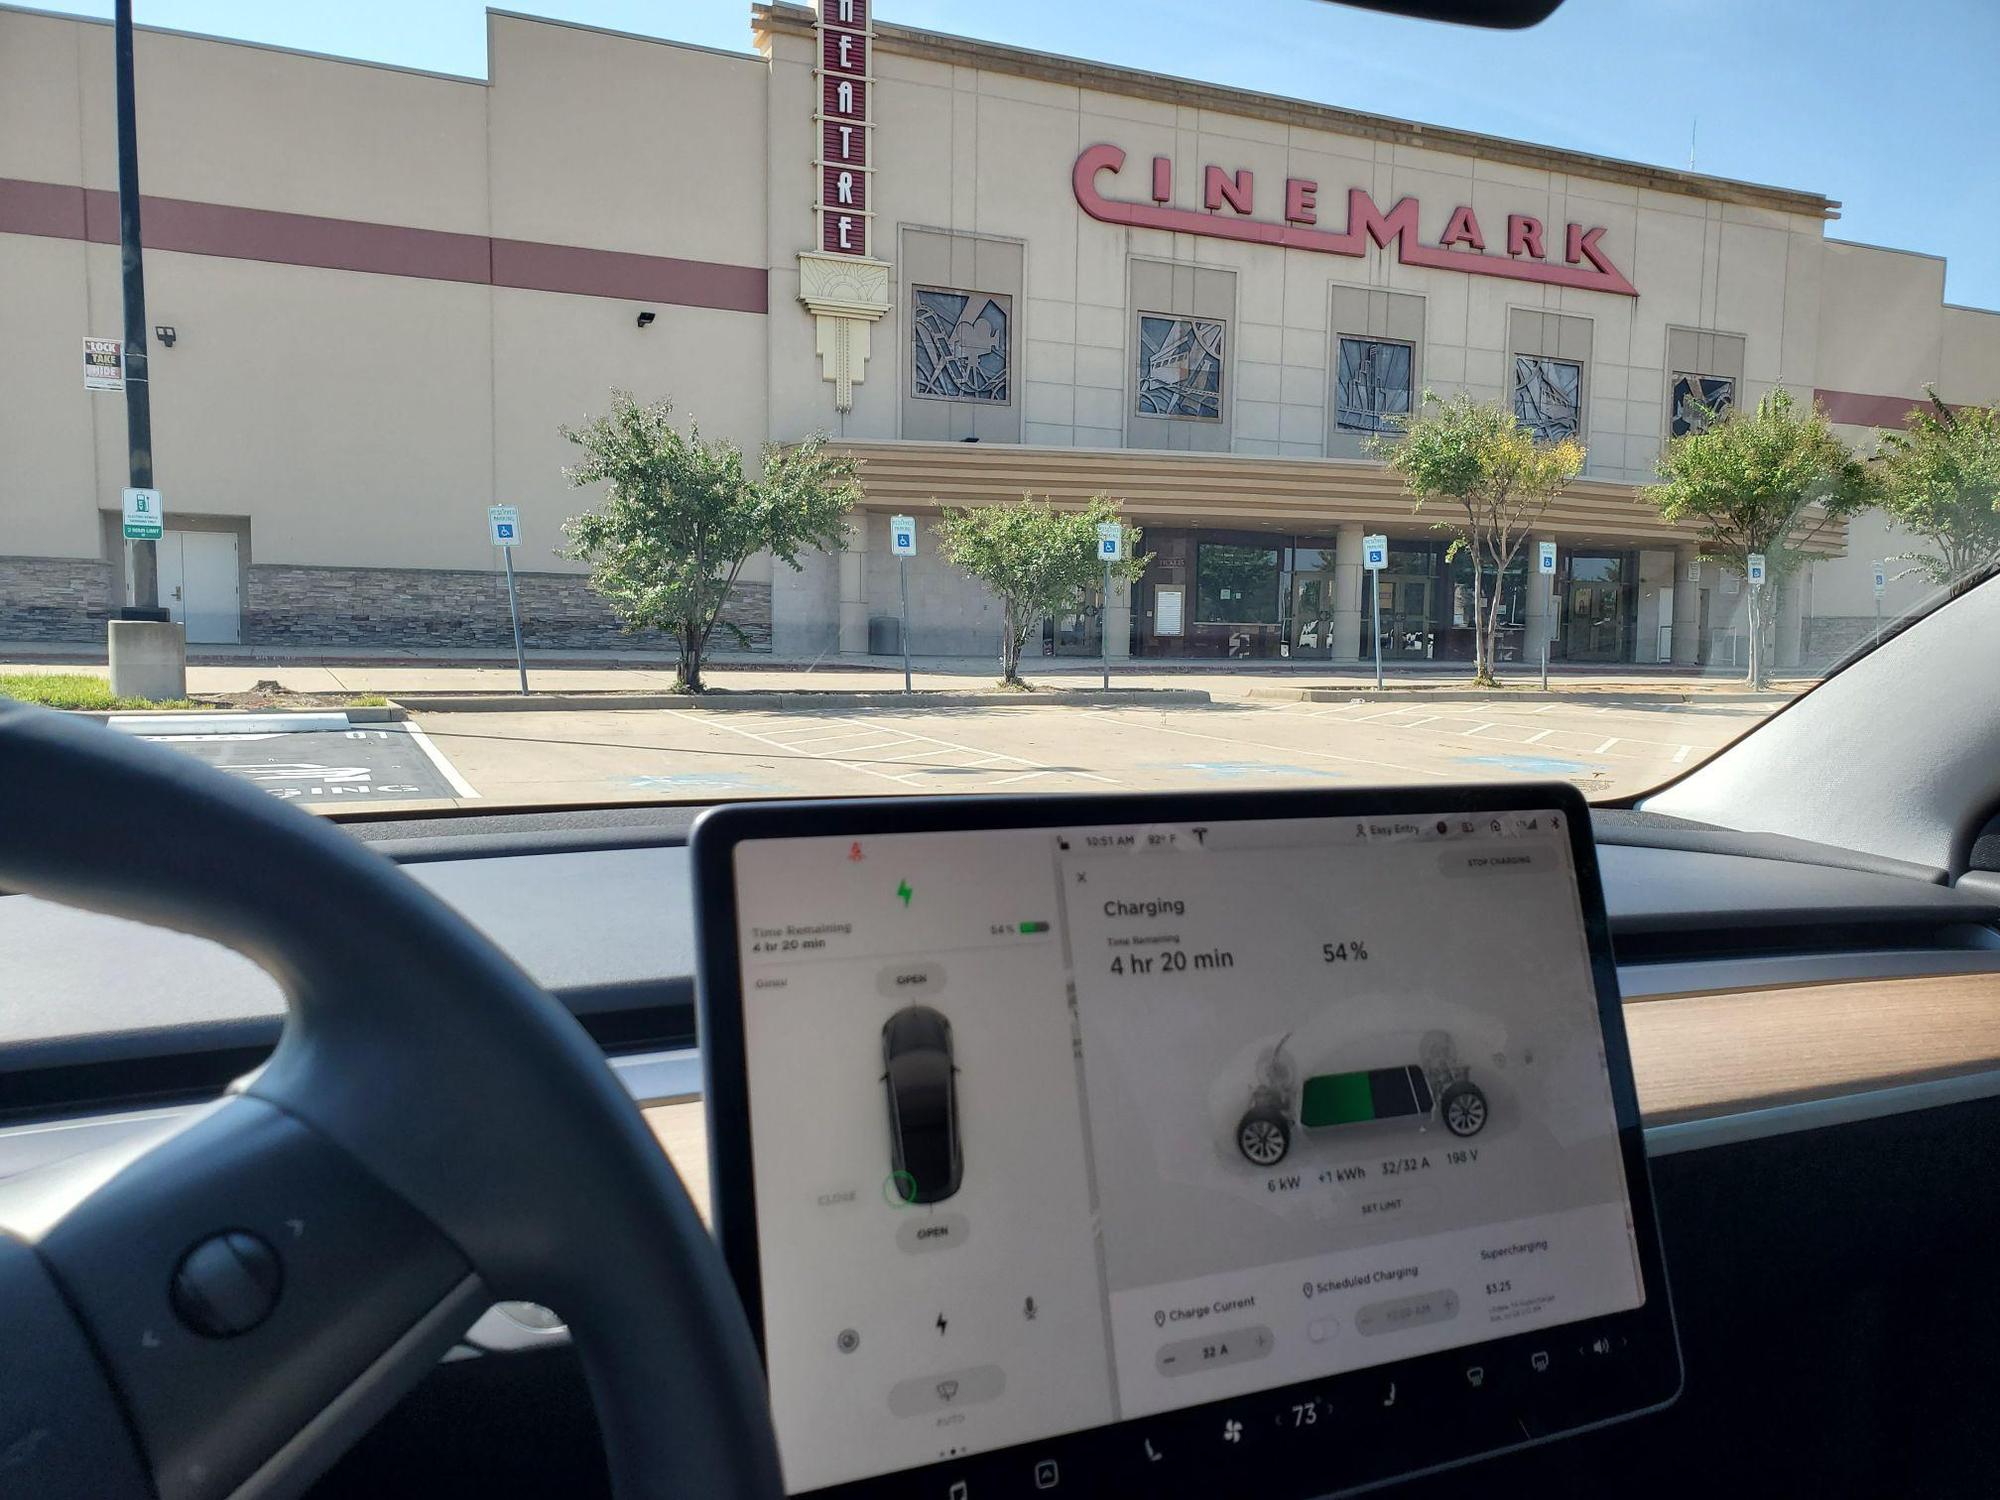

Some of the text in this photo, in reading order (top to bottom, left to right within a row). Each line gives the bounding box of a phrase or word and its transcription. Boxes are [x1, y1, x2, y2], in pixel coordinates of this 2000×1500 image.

[1073, 144, 1640, 297] CINEMARK
[90, 342, 116, 352] LOCK
[91, 353, 116, 364] TAKE
[91, 366, 116, 376] HIDE
[1370, 823, 1420, 836] Easy Entry
[1116, 835, 1135, 846] AM
[1103, 897, 1185, 917] Charging
[751, 921, 852, 938] Time Remaining
[752, 937, 826, 953] 4 hr 20 min
[1107, 933, 1180, 947] Time Remaining
[1110, 949, 1234, 975] 4 hr 20 min
[896, 974, 928, 986] OPEN
[1469, 1150, 1478, 1161] V
[1382, 1157, 1430, 1175] 32/32 A
[1336, 1167, 1366, 1182] kWh
[1267, 1176, 1300, 1192] 6 kW
[916, 1226, 949, 1240] OPEN
[1480, 1239, 1548, 1261] Supercharging
[1316, 1266, 1419, 1294] Scheduled Charging
[1169, 1296, 1255, 1322] Charge Current
[1219, 1344, 1228, 1355] A
[1292, 1402, 1317, 1426] 73
